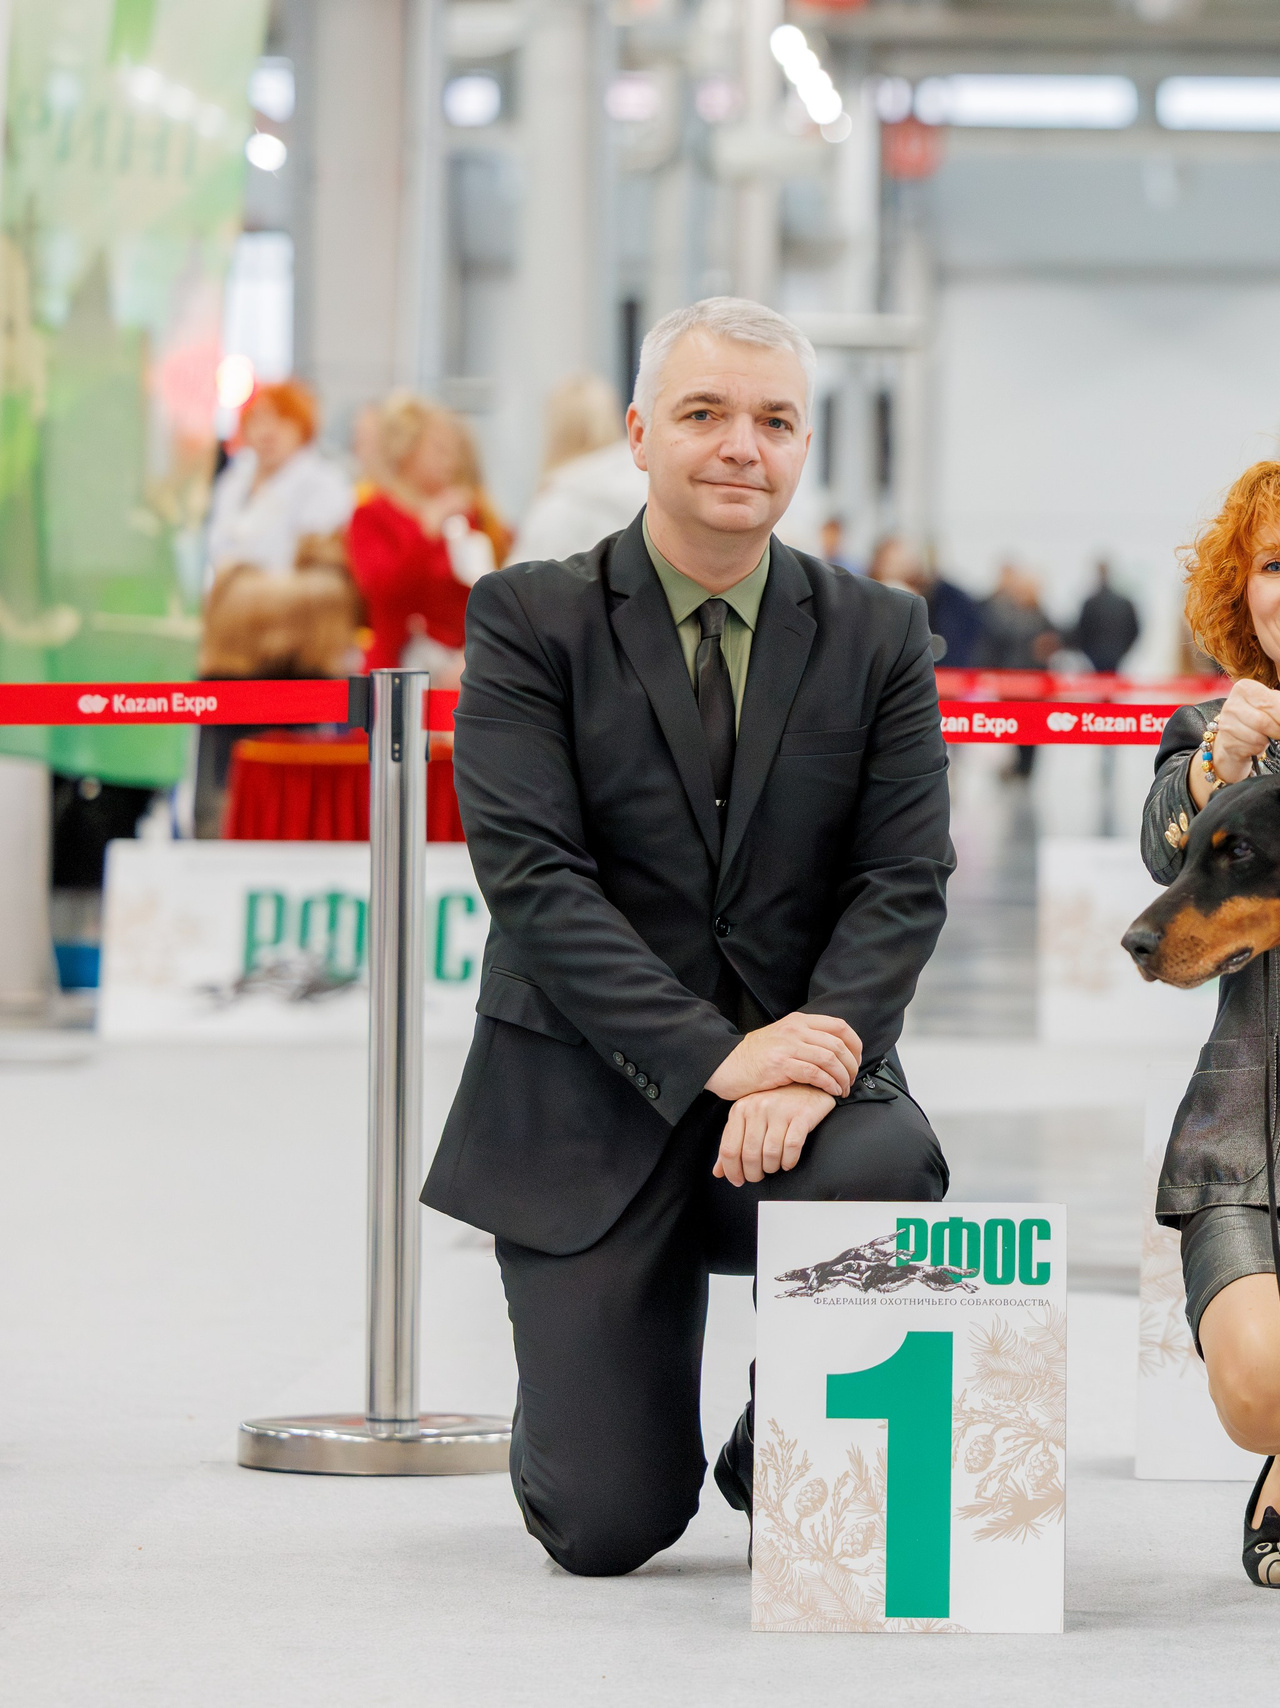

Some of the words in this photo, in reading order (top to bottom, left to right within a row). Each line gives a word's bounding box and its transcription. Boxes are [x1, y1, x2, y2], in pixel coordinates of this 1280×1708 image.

[113, 694, 169, 713] Kazan
[172, 692, 218, 716] Expo
[940, 716, 970, 733] zan
[972, 713, 1018, 738] Expo
[1081, 712, 1137, 733] Kazan
[1139, 713, 1172, 733] Ex
[244, 887, 478, 984] РФС
[895, 1216, 1052, 1286] РФОС
[813, 1297, 877, 1307] ФЕДЕРАЦИЯ
[880, 1297, 957, 1307] ОХОТНИЧЬЕГО
[960, 1298, 1051, 1307] СОБАКОВОДСТВА
[826, 1331, 953, 1619] 1
